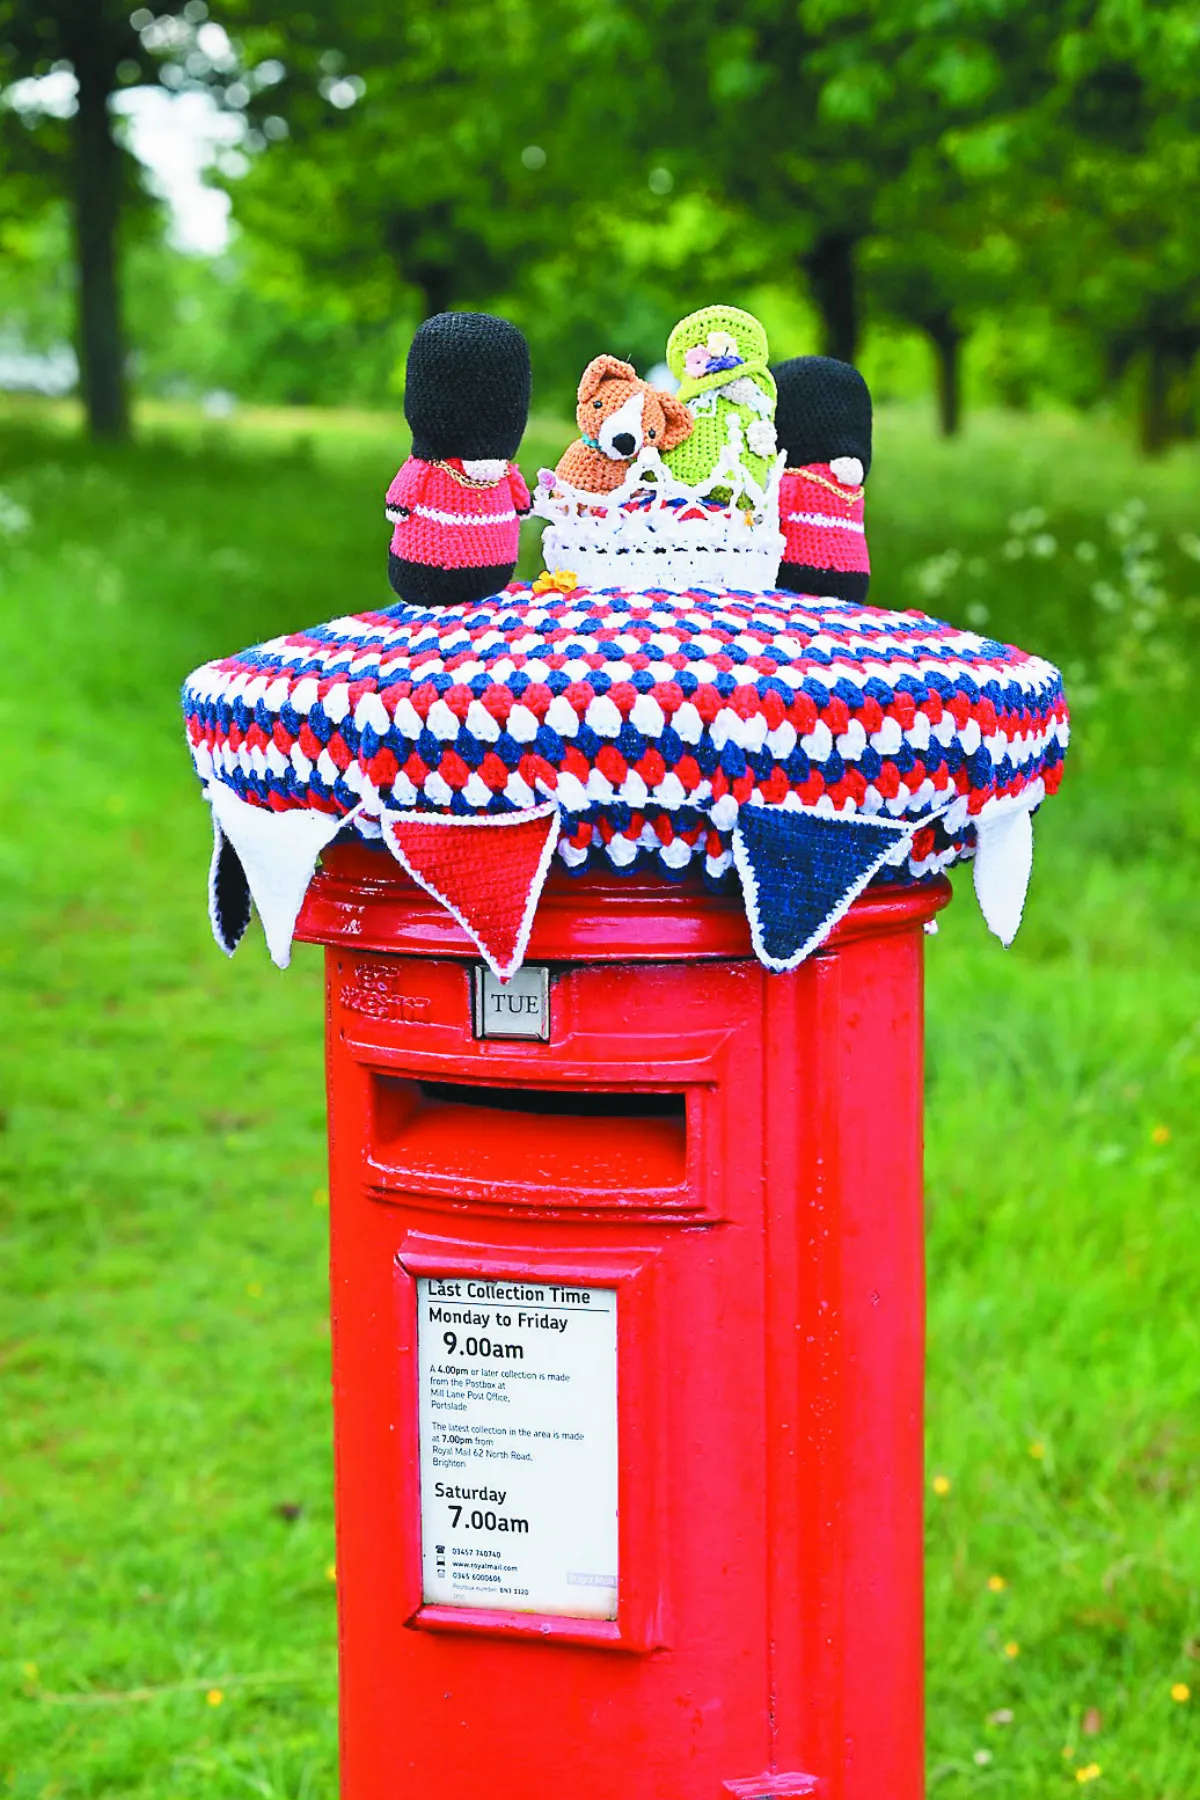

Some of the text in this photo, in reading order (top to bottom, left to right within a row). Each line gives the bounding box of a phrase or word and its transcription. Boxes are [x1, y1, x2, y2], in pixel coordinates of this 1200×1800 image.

[491, 994, 539, 1014] TUE
[428, 1280, 590, 1304] Last Collection Time
[429, 1308, 567, 1332] Monday to Friday
[444, 1332, 524, 1359] 9.00am
[430, 1365, 436, 1373] A
[438, 1365, 468, 1377] 4.00pm
[481, 1368, 498, 1377] later
[501, 1370, 536, 1380] collection
[539, 1372, 545, 1380] is
[548, 1373, 570, 1382] made
[430, 1378, 448, 1386] from
[451, 1378, 463, 1387] the
[465, 1380, 496, 1389] Postbox
[431, 1389, 444, 1398] Mill
[447, 1390, 465, 1399] Lane
[468, 1392, 484, 1400] Post
[432, 1400, 467, 1411] Portslade
[432, 1422, 584, 1440] The latest collection in the area is made
[442, 1435, 473, 1446] 7.00pm
[475, 1437, 493, 1445] from
[433, 1446, 453, 1457] Royal
[455, 1447, 471, 1457] Mail
[473, 1449, 483, 1457] 62
[486, 1450, 508, 1459] North
[433, 1458, 466, 1469] Brighton
[435, 1483, 506, 1505] Saturday
[448, 1505, 529, 1533] 7.00am
[452, 1548, 501, 1558] 03457 740740
[453, 1561, 518, 1573] www.royalmail.com
[453, 1572, 501, 1583] 0345 6000606
